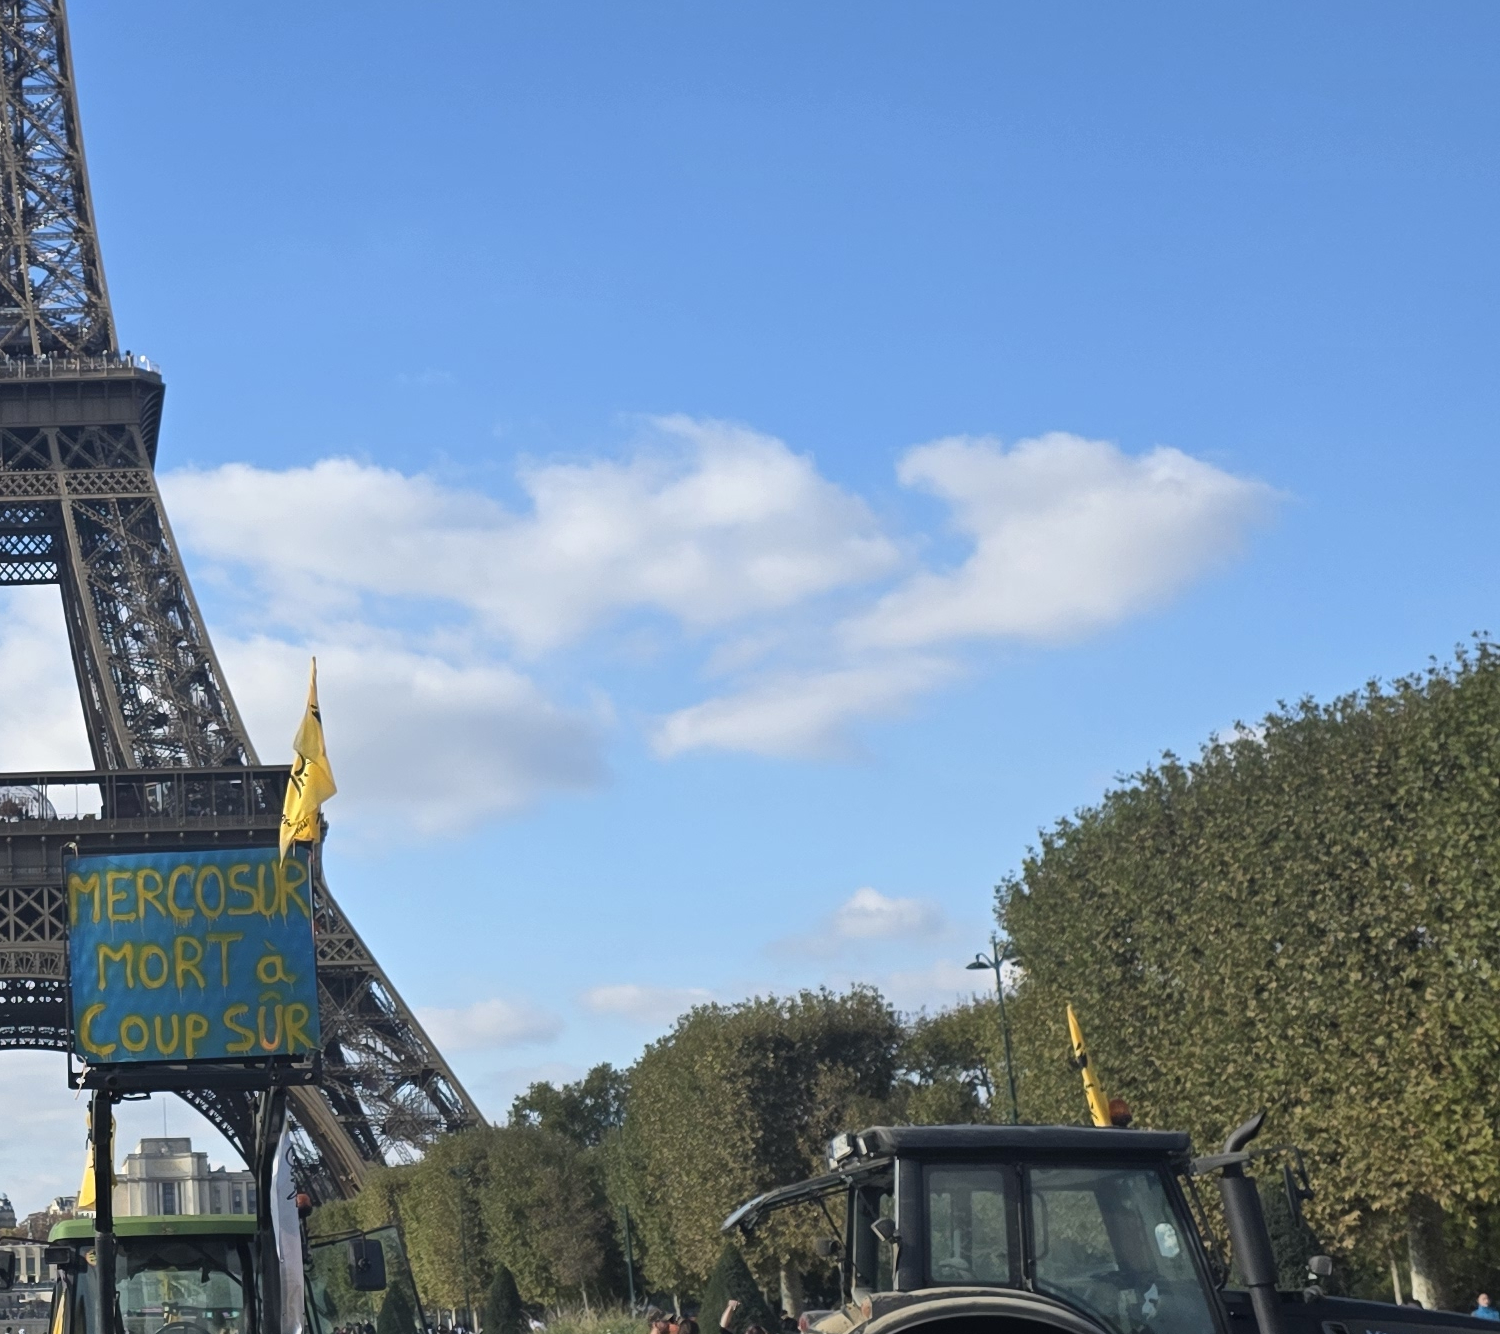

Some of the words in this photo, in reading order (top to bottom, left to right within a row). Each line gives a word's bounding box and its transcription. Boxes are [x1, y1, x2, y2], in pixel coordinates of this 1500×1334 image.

[68, 860, 310, 927] MERCOSUR
[97, 932, 244, 991] MORT
[257, 939, 296, 987] à
[79, 1003, 209, 1059] COUP
[223, 992, 313, 1055] SÛR
